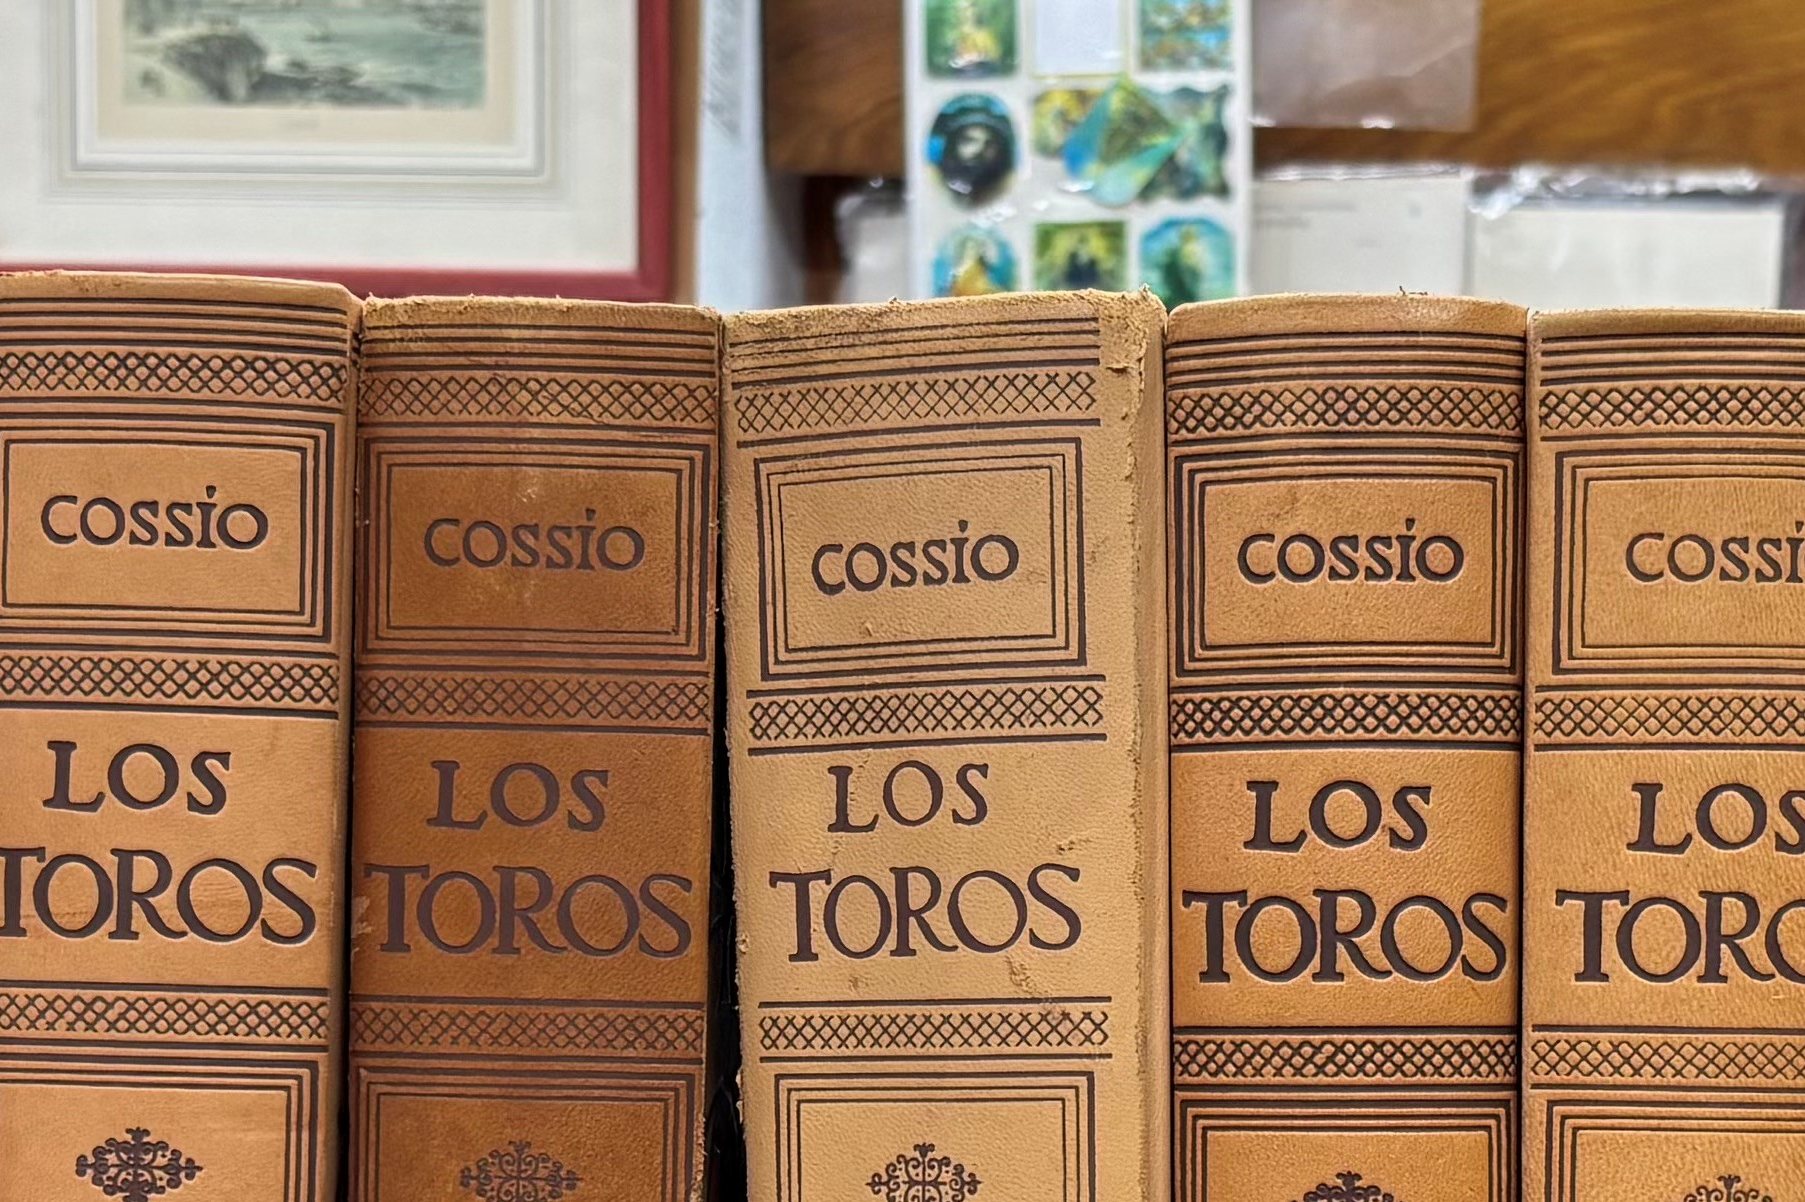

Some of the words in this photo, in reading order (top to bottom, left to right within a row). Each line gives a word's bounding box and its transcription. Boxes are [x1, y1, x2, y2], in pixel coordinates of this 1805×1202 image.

[40, 485, 269, 550] COSSÍO
[422, 508, 645, 571] COSSÍO
[1237, 517, 1465, 584] COSSÍO
[811, 519, 1020, 596] COSSÍO
[42, 740, 231, 815] LOS
[426, 760, 610, 832] LOS
[828, 760, 990, 834] LOS
[1243, 780, 1432, 855] LOS
[364, 865, 693, 959] TOROS
[769, 863, 1082, 963] TOROS
[1182, 889, 1508, 984] TOROS
